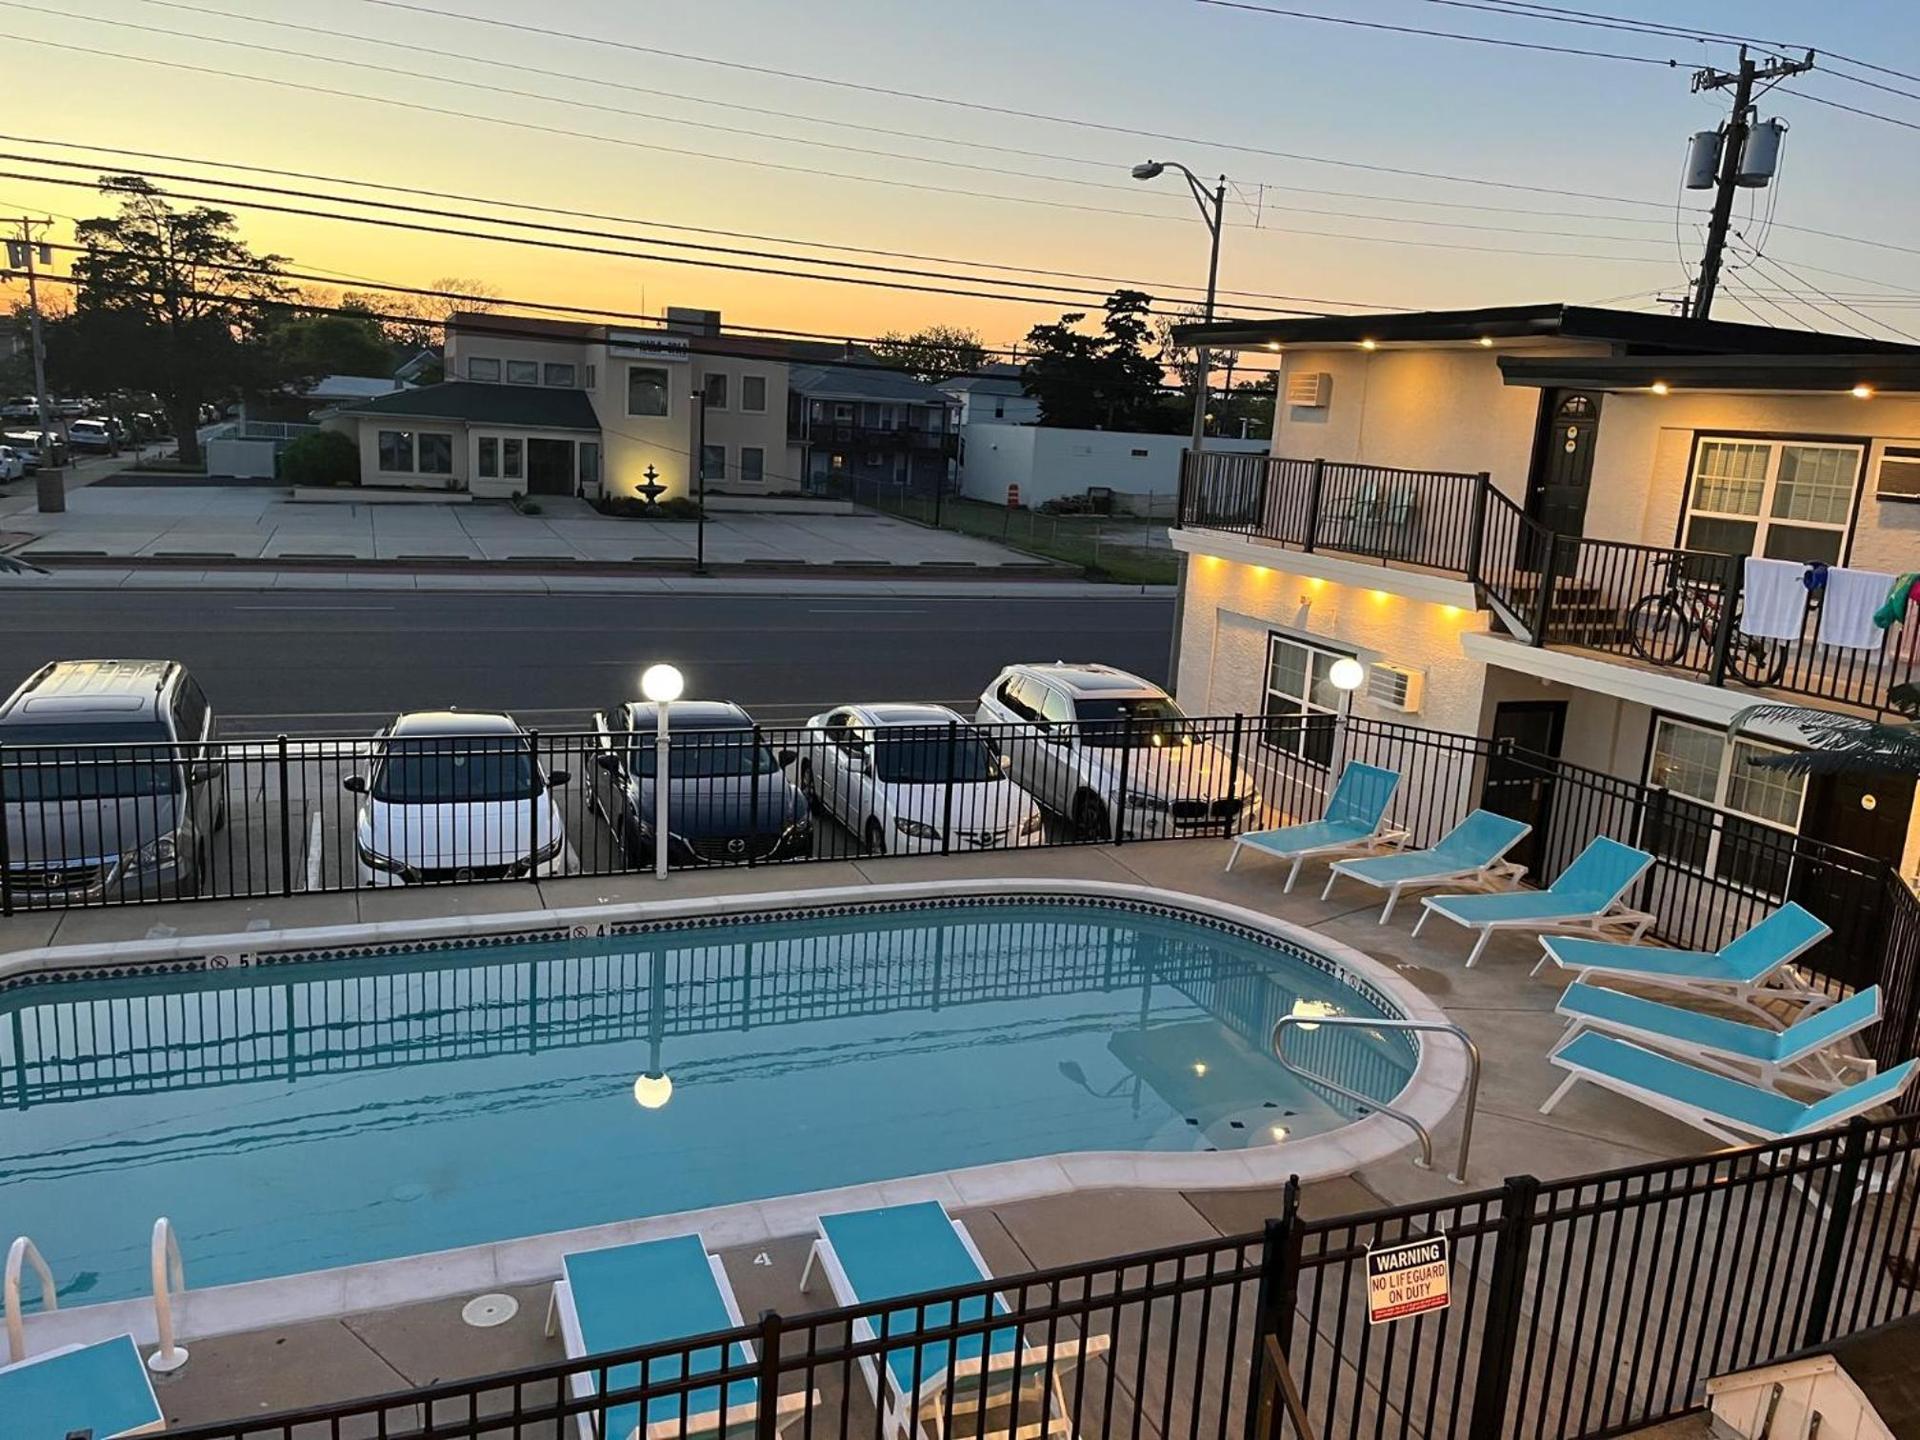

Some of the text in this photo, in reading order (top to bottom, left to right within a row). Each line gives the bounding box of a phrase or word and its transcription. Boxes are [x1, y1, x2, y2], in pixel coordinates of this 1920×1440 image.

[596, 924, 605, 938] 4
[240, 954, 249, 969] 5
[753, 1252, 773, 1266] 4
[1376, 1244, 1440, 1272] WARNING
[1372, 1264, 1446, 1292] NO LIFEGUARD
[1389, 1282, 1432, 1304] ON DUTY
